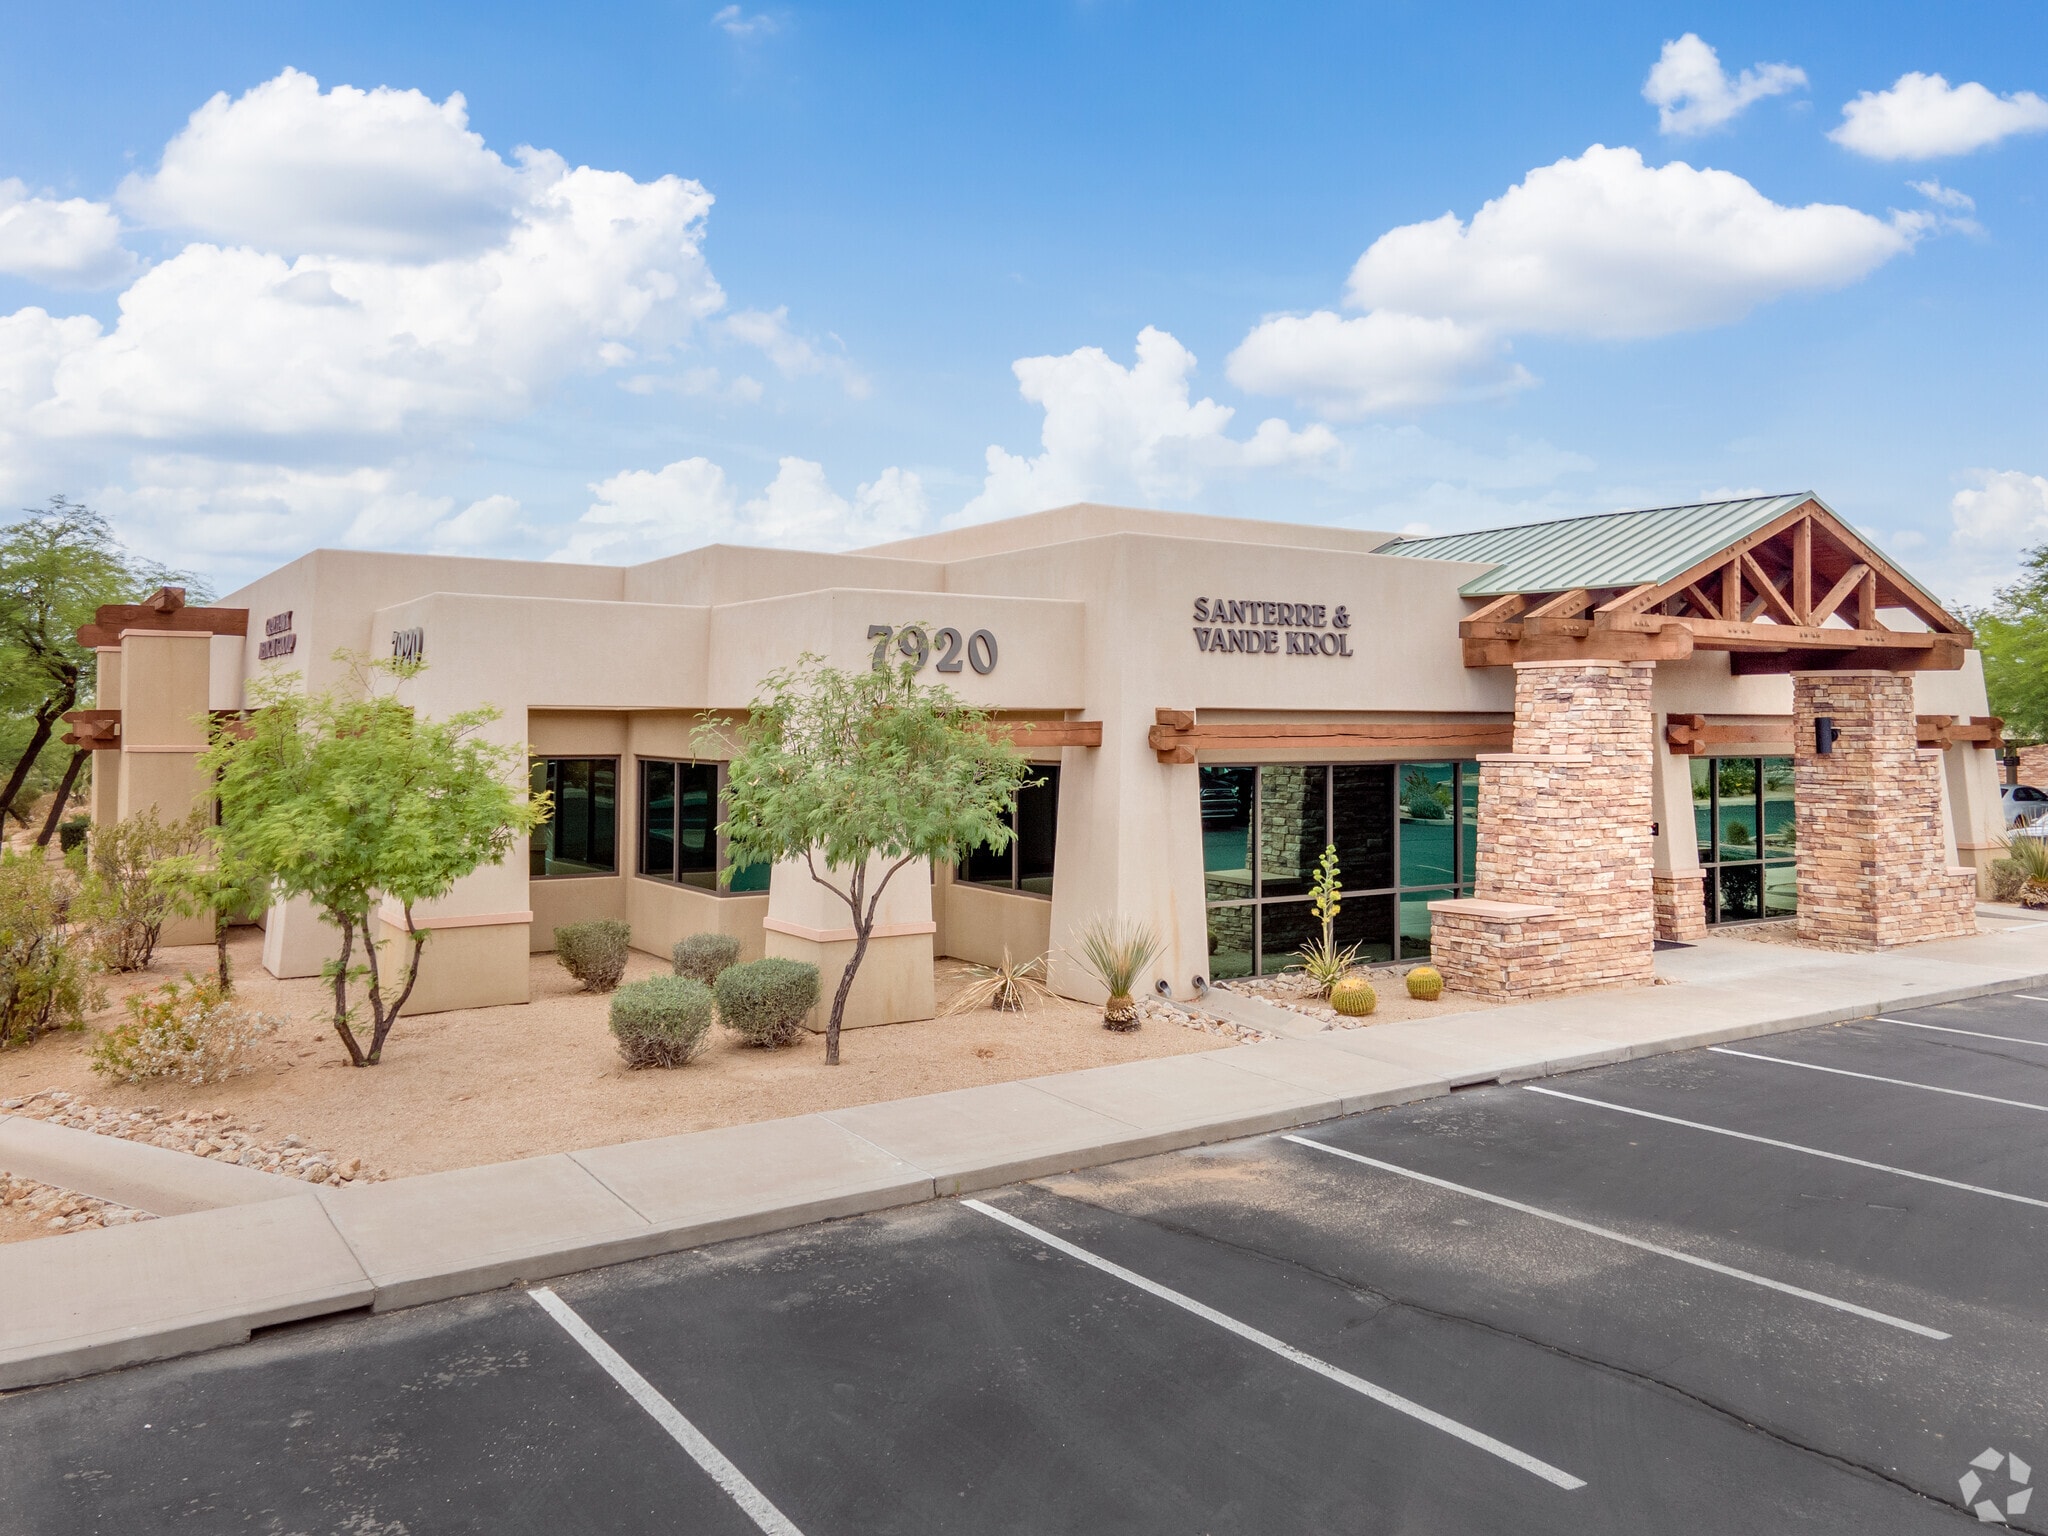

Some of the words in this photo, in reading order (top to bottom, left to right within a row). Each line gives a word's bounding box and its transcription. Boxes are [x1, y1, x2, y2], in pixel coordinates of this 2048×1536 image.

[1193, 597, 1327, 627] SANTERRE
[1332, 605, 1351, 628] &
[867, 624, 998, 675] 7920
[1193, 627, 1280, 654] VANDE
[1285, 631, 1353, 656] KROL
